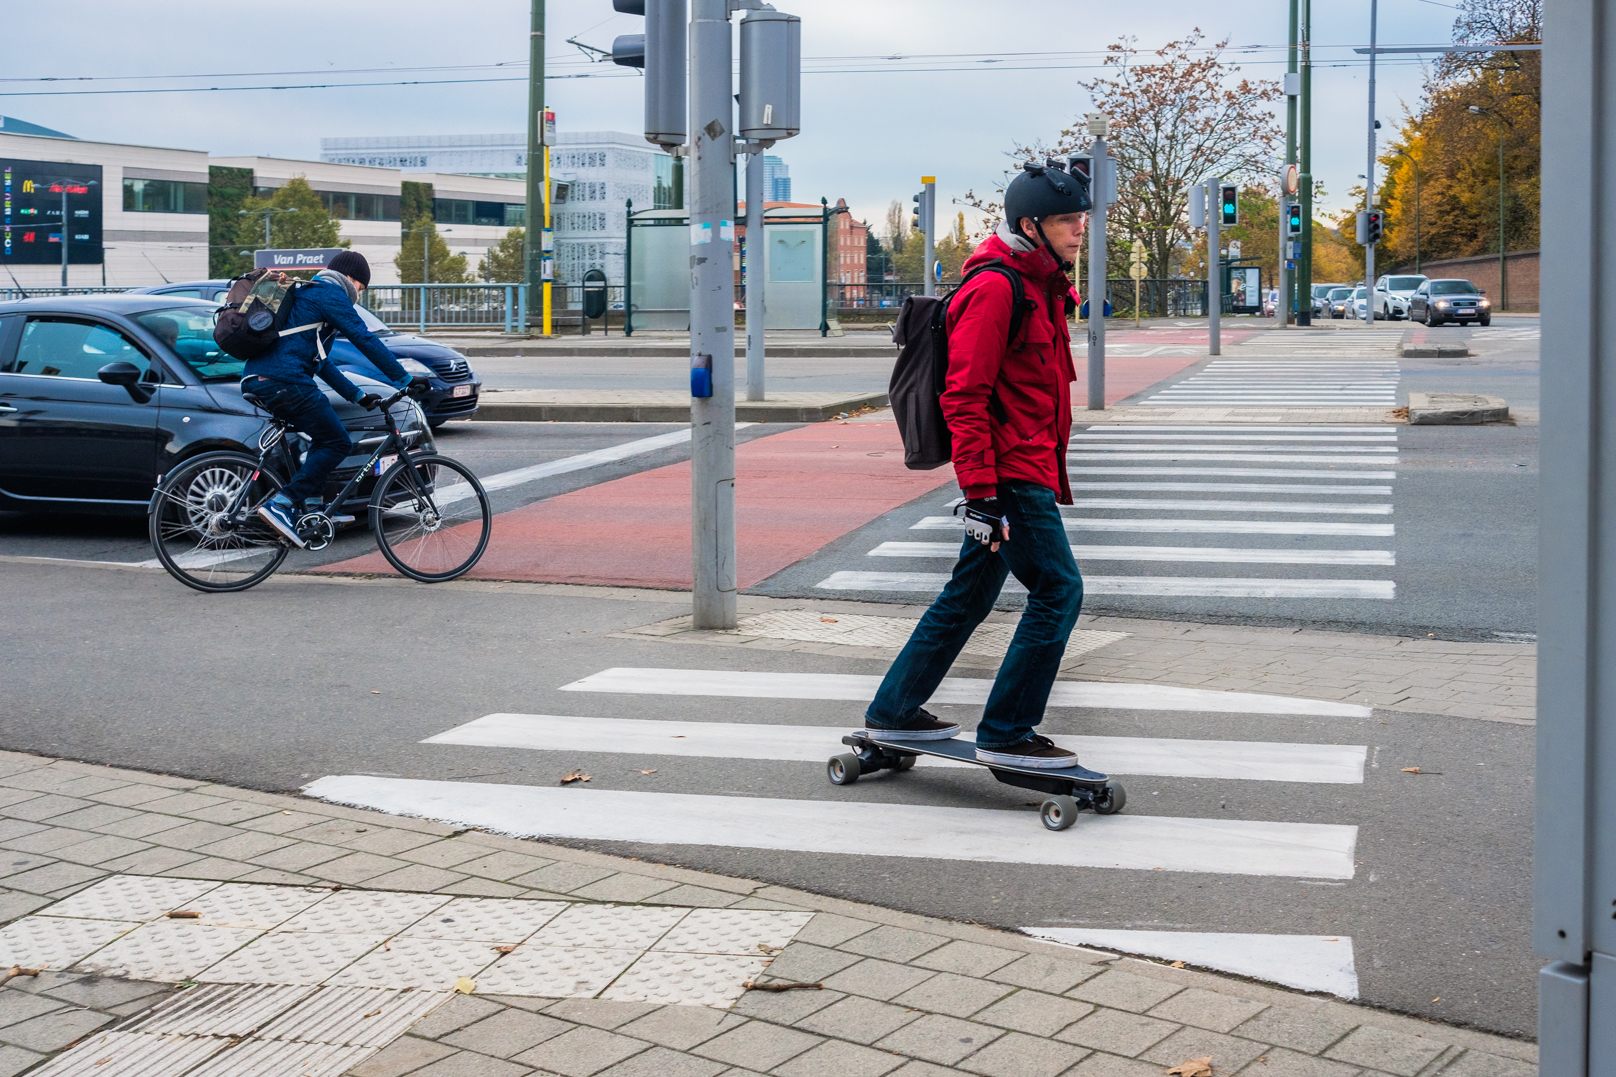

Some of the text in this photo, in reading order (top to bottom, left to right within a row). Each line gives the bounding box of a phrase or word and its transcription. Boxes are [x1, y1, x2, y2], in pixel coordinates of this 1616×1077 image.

[273, 253, 324, 265] Van Praet
[355, 453, 379, 482] ortler
